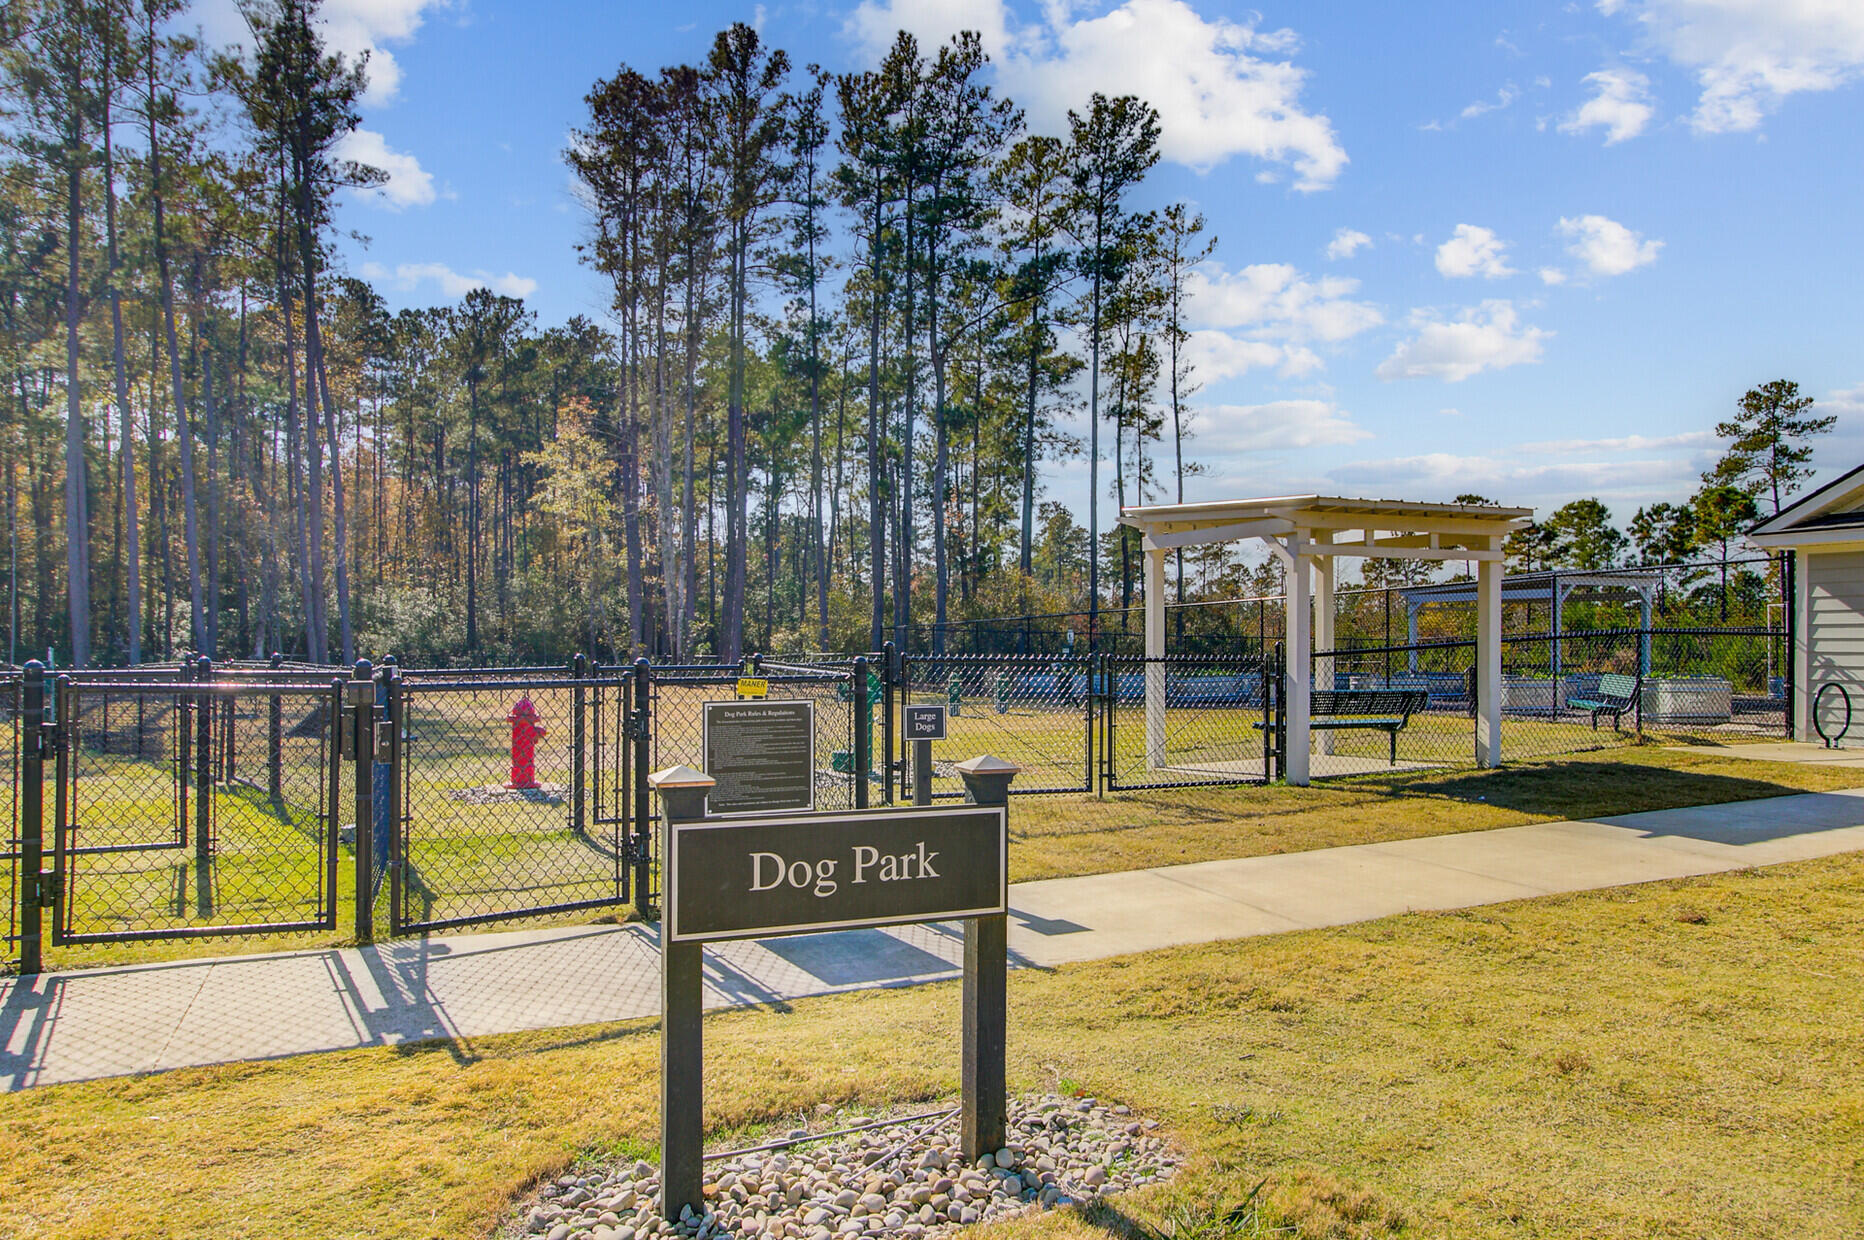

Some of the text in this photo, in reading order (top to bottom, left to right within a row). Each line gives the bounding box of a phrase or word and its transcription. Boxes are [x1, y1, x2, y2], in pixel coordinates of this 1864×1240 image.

[914, 712, 936, 722] Large
[915, 722, 936, 732] Dogs
[749, 841, 941, 898] Dog Park
